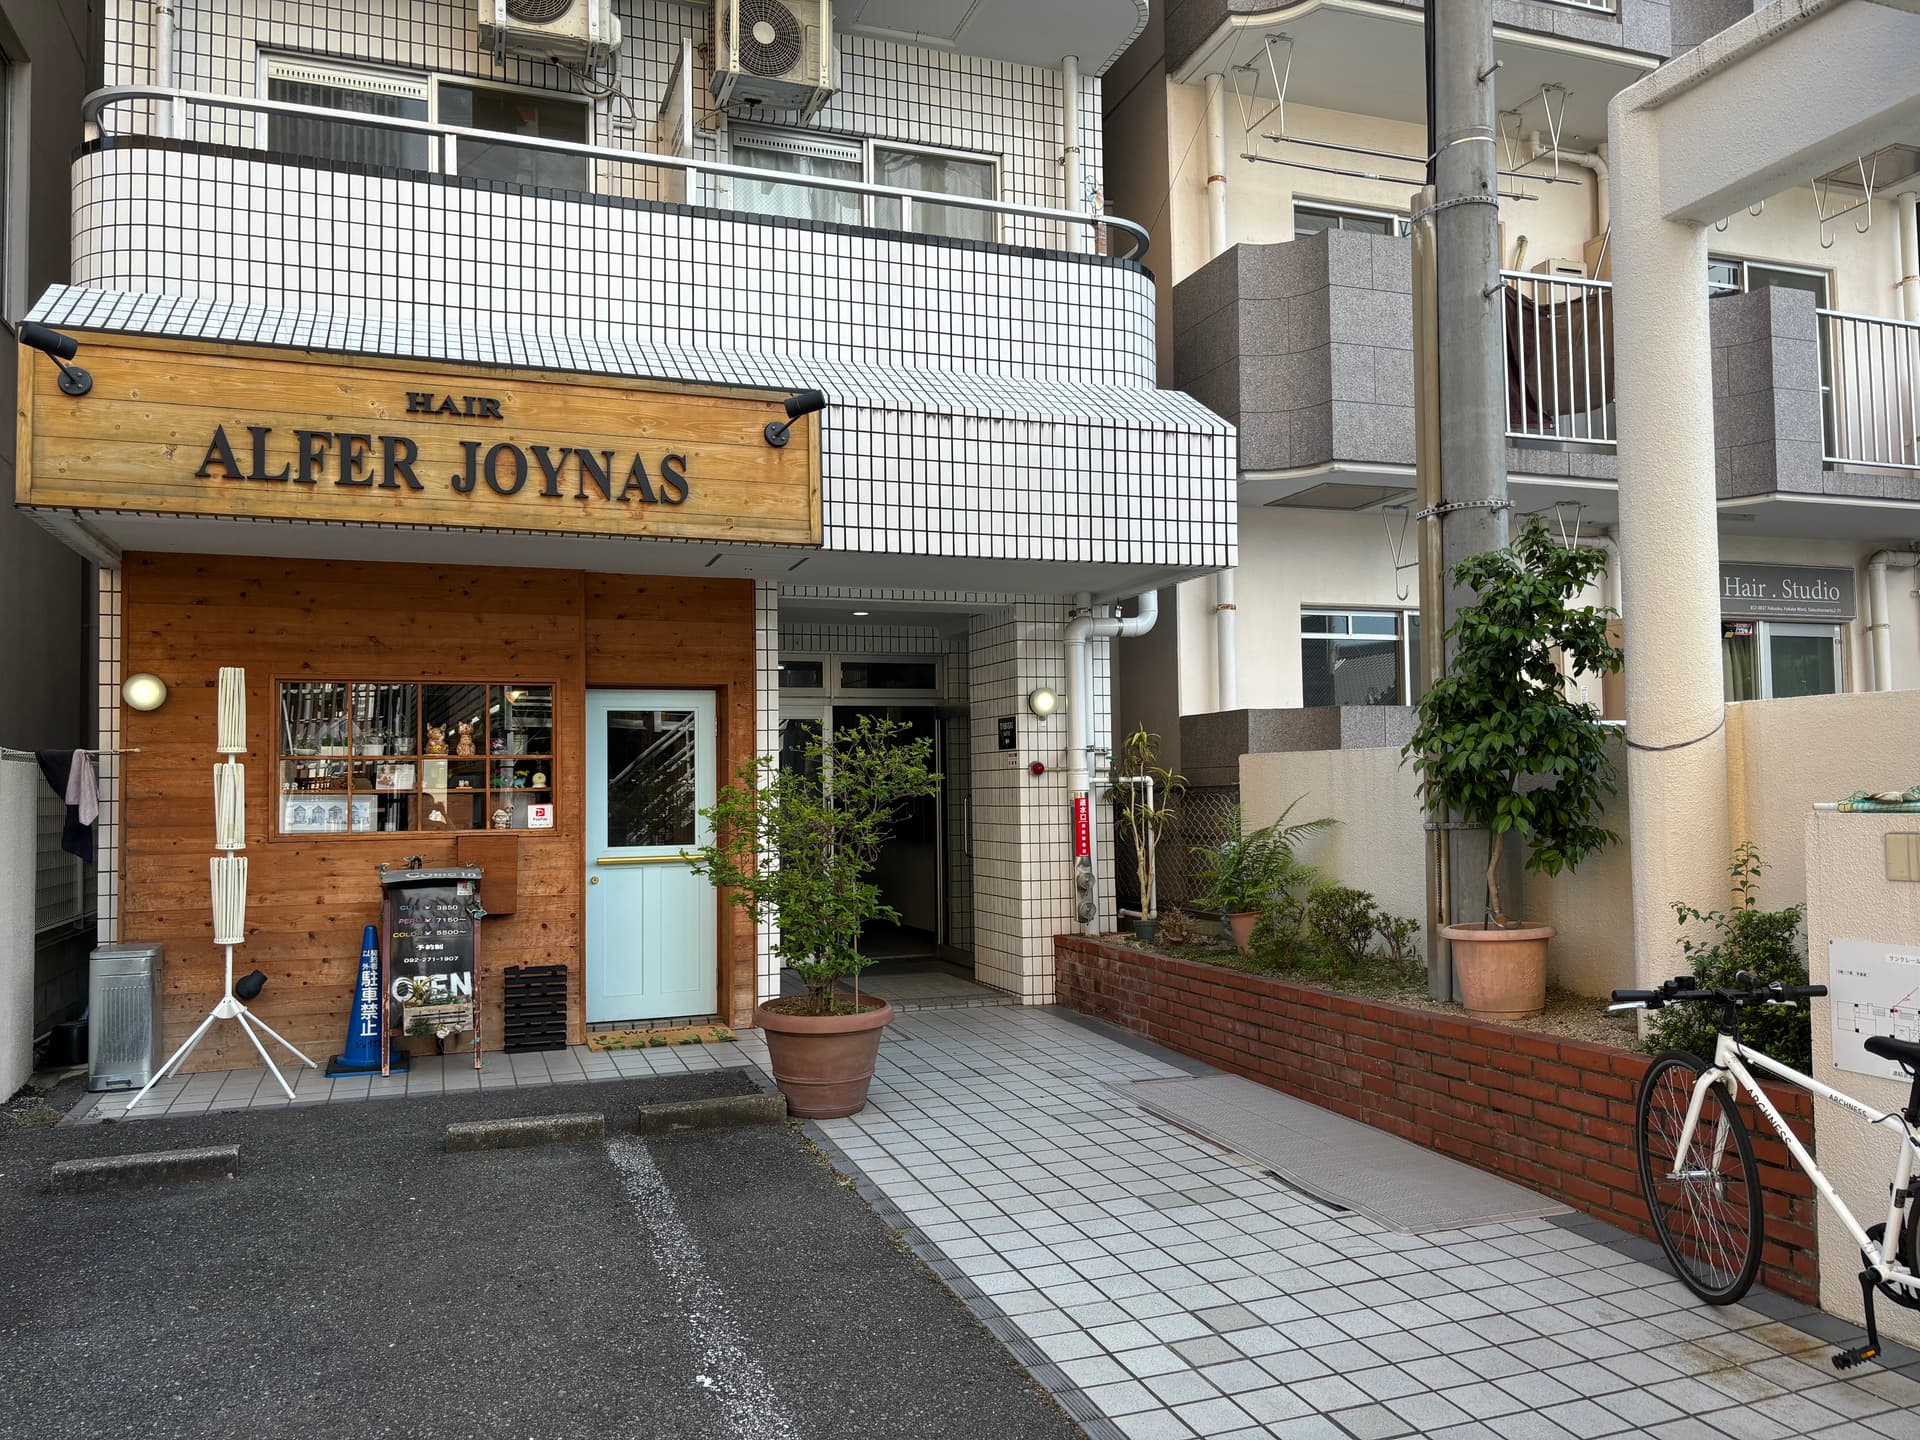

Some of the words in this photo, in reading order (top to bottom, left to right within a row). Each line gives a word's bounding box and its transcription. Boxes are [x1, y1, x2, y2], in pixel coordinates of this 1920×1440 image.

[406, 392, 503, 419] HAIR
[195, 424, 425, 490] ALFER
[451, 440, 690, 505] JOYNAS
[1724, 576, 1766, 598] Hair
[1782, 578, 1840, 601] Studio
[360, 970, 379, 1036] 駐車禁止
[1746, 1089, 1792, 1144] ARCHNESS
[1828, 1093, 1868, 1117] ARCHNESS
